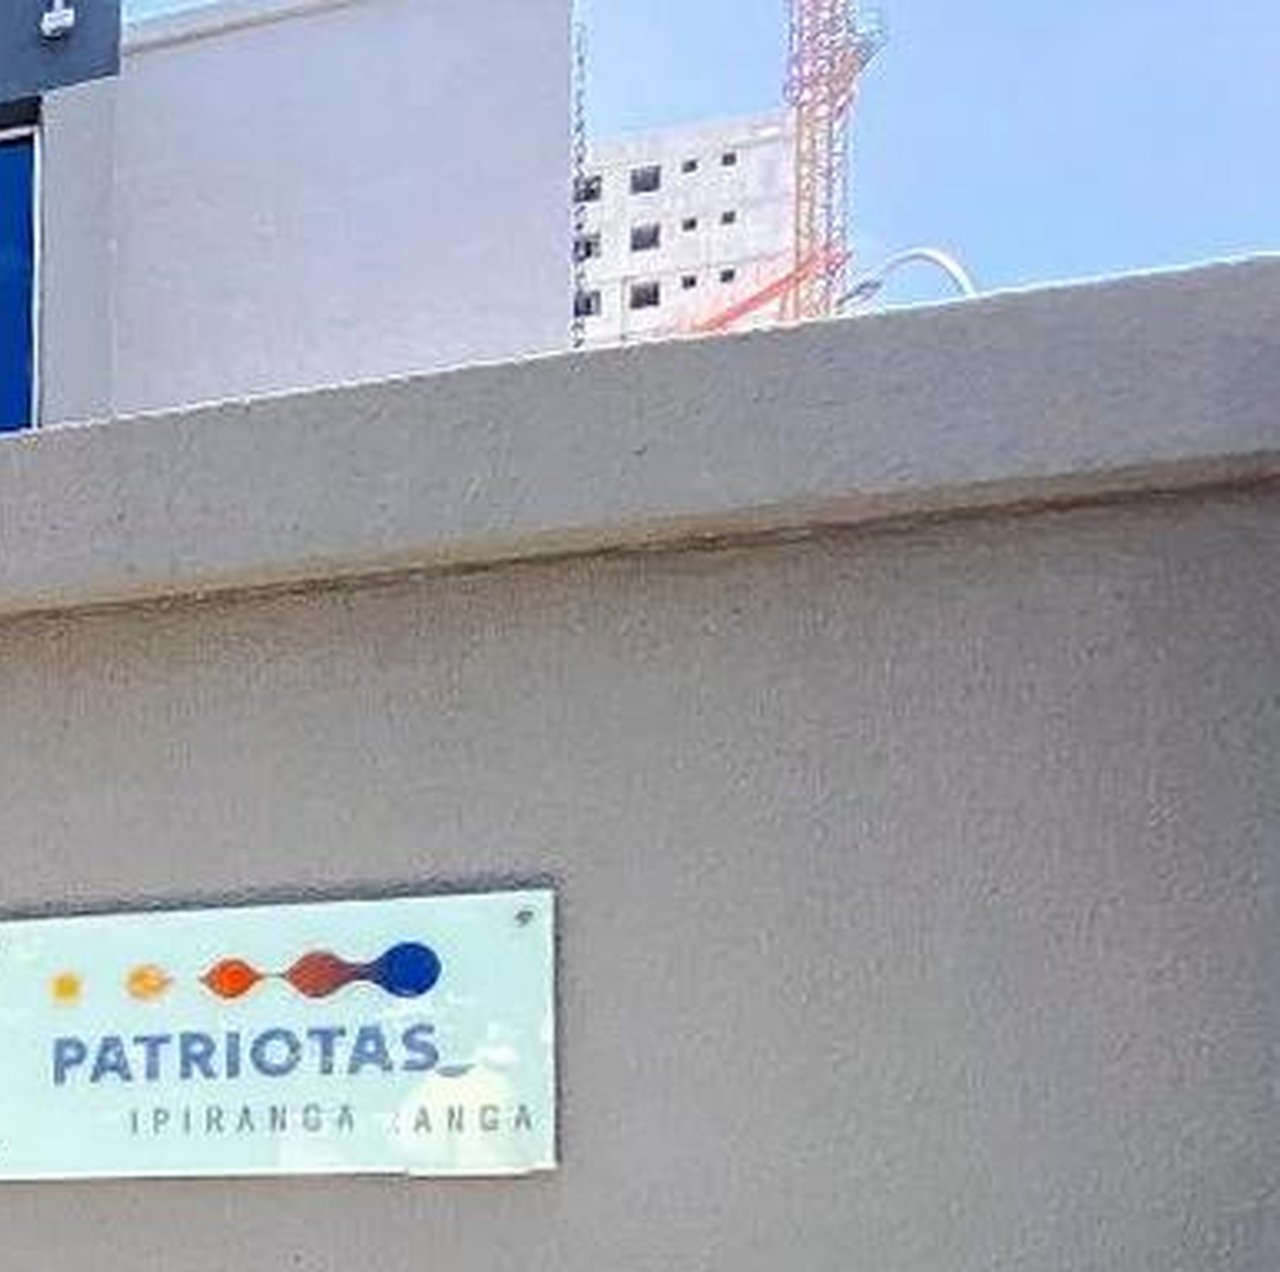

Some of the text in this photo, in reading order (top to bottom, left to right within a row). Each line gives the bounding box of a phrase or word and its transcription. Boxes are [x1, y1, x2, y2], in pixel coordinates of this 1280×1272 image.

[52, 1022, 439, 1086] PATRIOTAS
[131, 1103, 535, 1136] IPIRANGA ANGA
